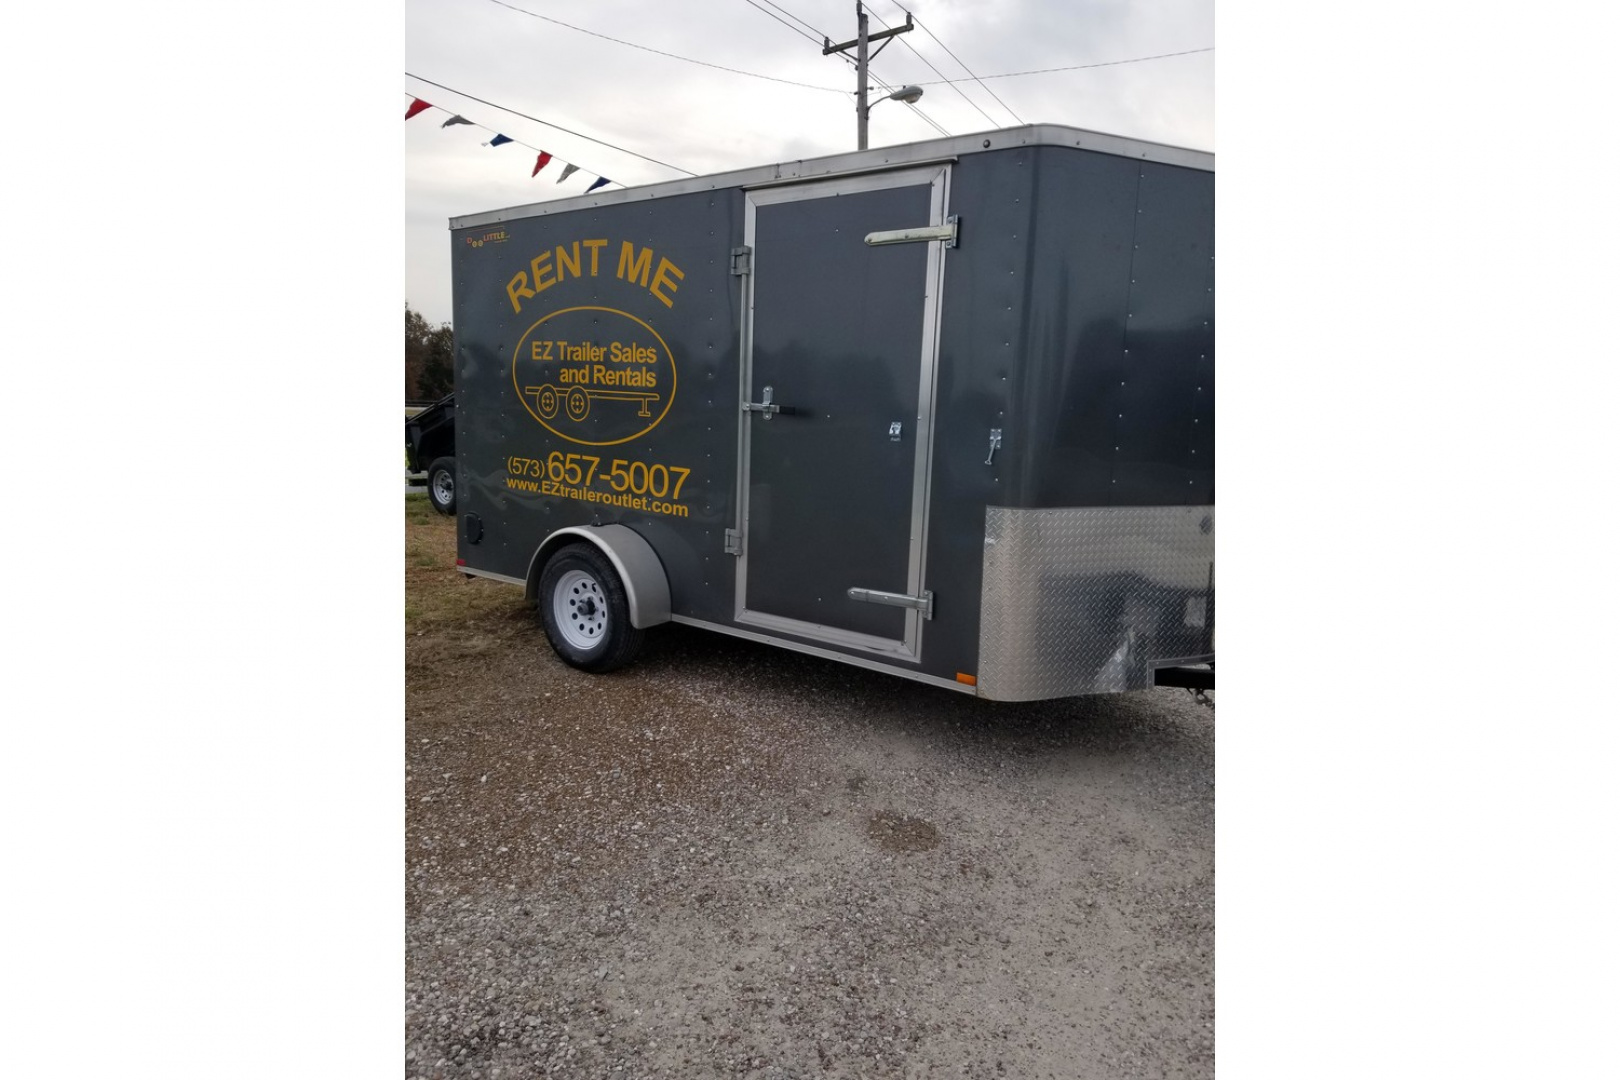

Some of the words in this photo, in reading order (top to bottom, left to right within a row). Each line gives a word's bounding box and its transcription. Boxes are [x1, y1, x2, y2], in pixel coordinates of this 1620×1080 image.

[506, 239, 608, 314] RENT
[617, 240, 685, 308] ME
[532, 341, 553, 360] EZ
[557, 341, 607, 362] Trailer
[610, 341, 657, 364] Sales
[559, 364, 589, 384] and
[593, 364, 657, 387] Rentals
[507, 455, 545, 479] (573)
[548, 451, 691, 500] 657-5007
[506, 478, 688, 517] www.EZtraileroutlet.com
